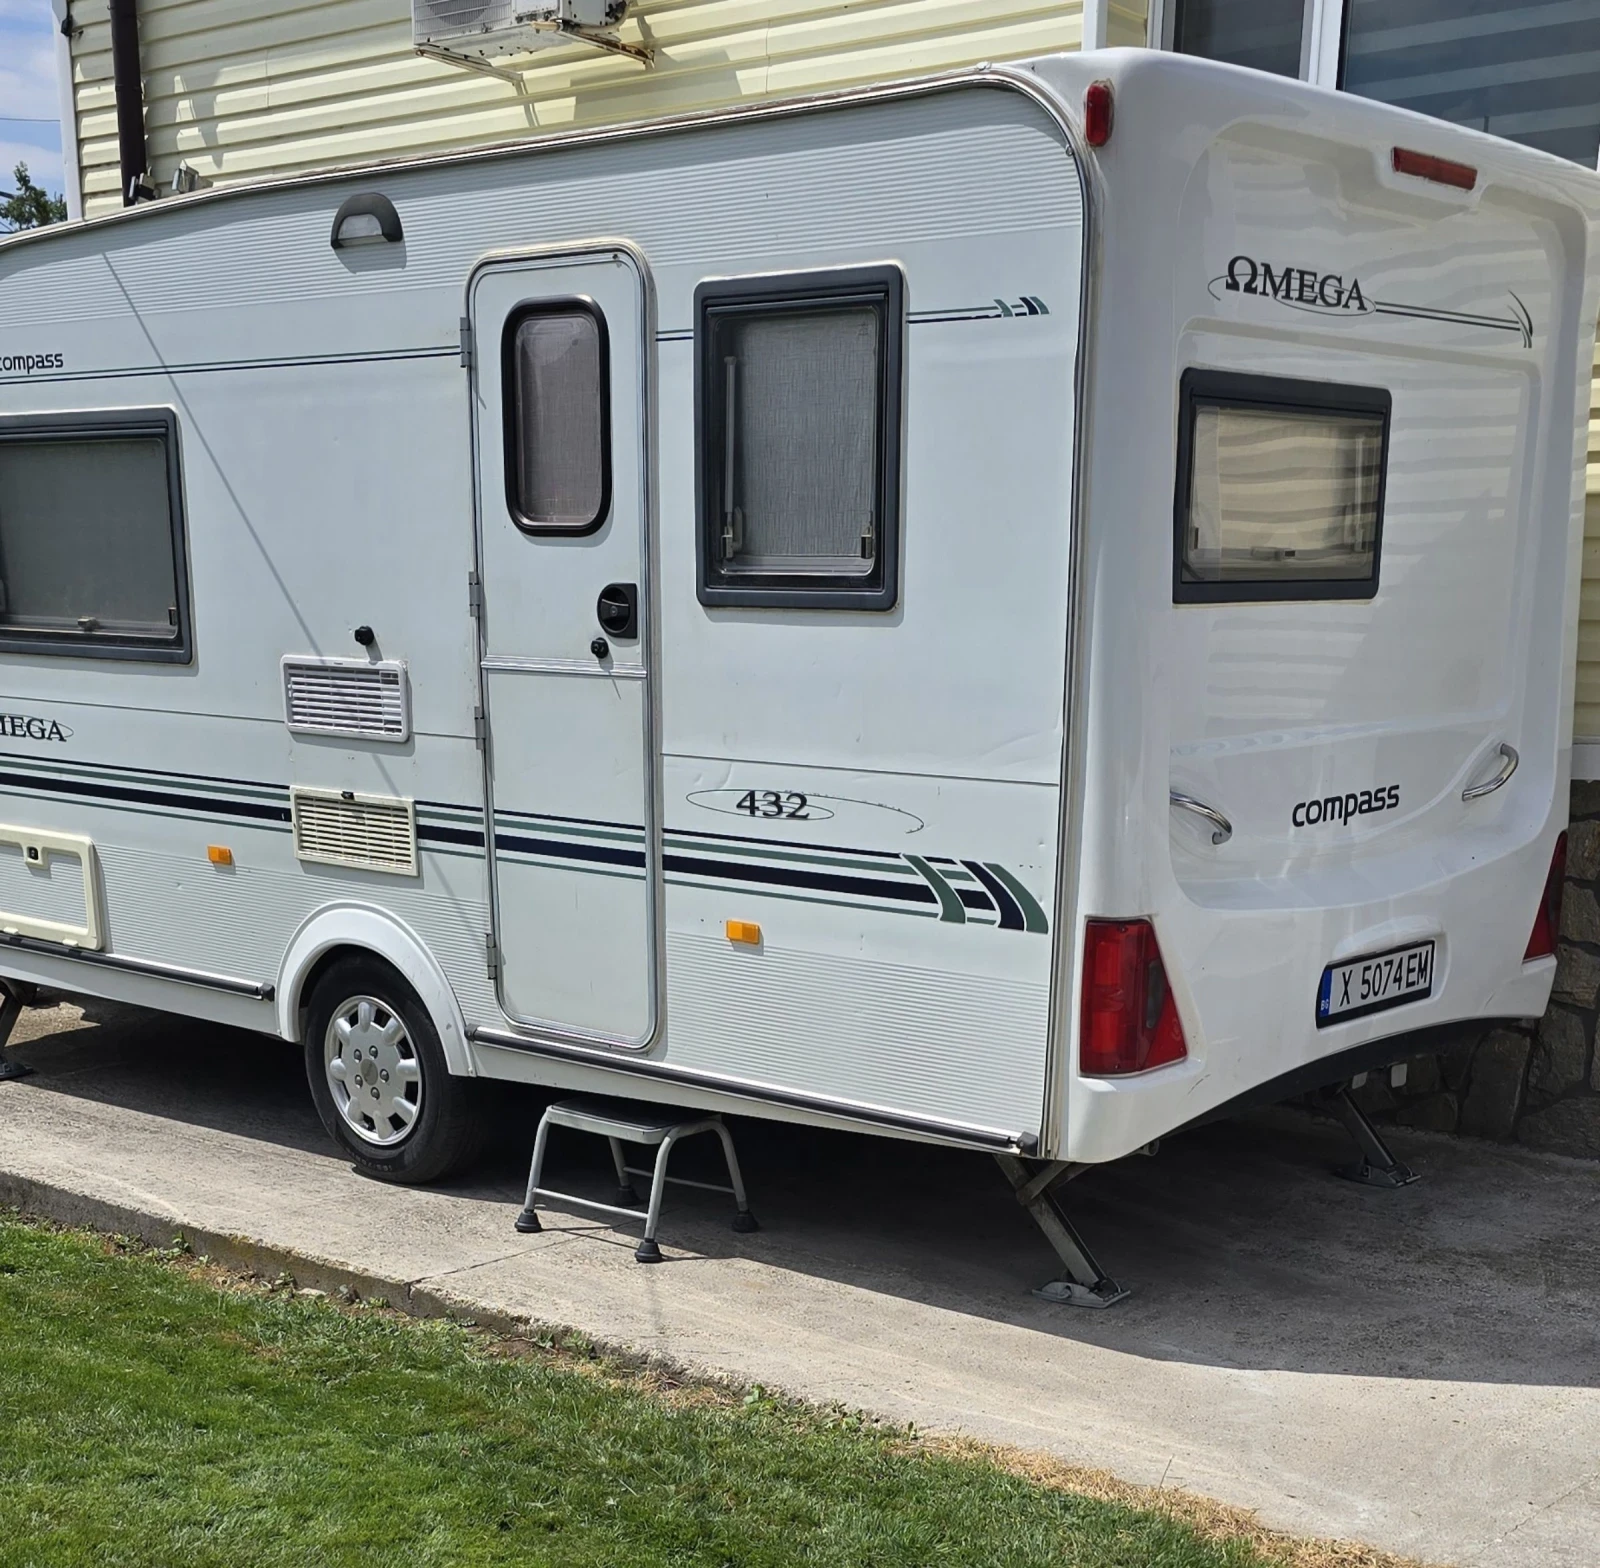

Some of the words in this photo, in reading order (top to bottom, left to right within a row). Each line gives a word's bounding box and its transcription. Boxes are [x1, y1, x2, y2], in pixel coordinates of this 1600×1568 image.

[0, 353, 64, 375] ompass
[736, 790, 810, 819] 432
[1292, 784, 1400, 827] compass
[1339, 969, 1353, 1007] X
[1360, 949, 1429, 1000] 5074EM
